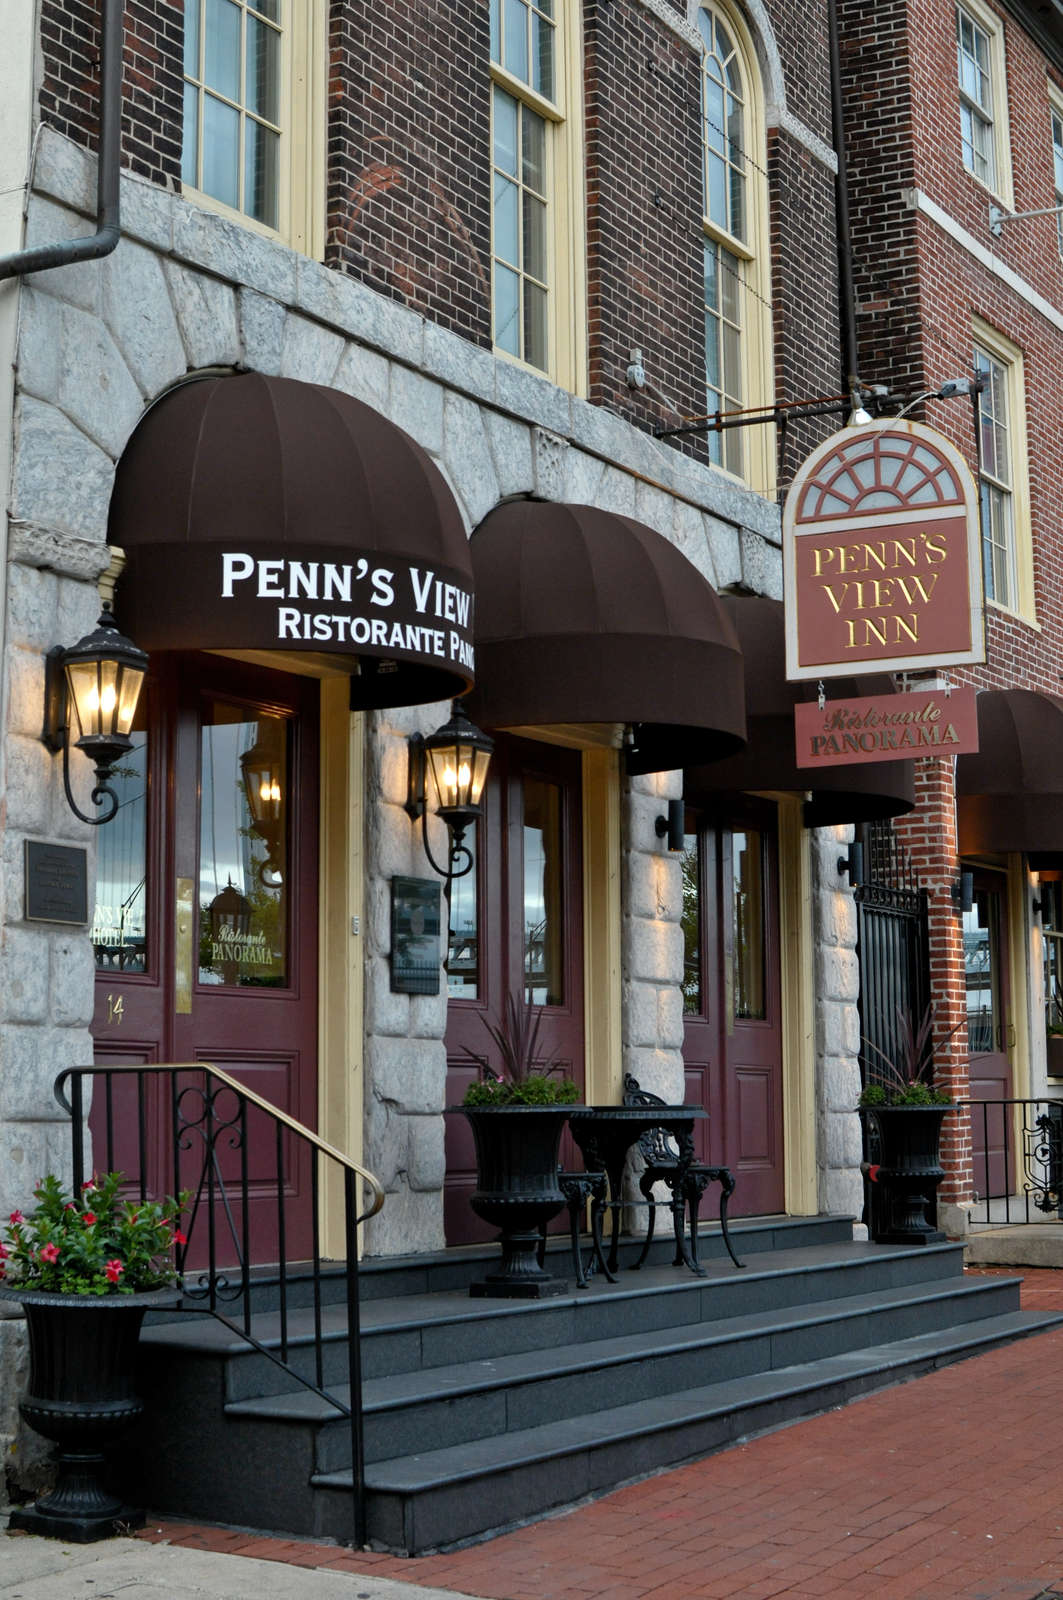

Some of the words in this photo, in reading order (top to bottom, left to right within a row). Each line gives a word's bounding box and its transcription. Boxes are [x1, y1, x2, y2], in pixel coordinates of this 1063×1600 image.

[811, 532, 947, 577] PENN'S
[221, 553, 395, 606] PENN'S
[409, 567, 470, 628] VIEW
[820, 573, 939, 614] VIEW
[278, 607, 445, 657] RISTORANTE
[844, 613, 919, 648] INN
[824, 701, 942, 732] Ristorante
[811, 723, 960, 756] PANORAMA
[212, 942, 273, 965] PANORAMA
[108, 994, 124, 1024] 14
